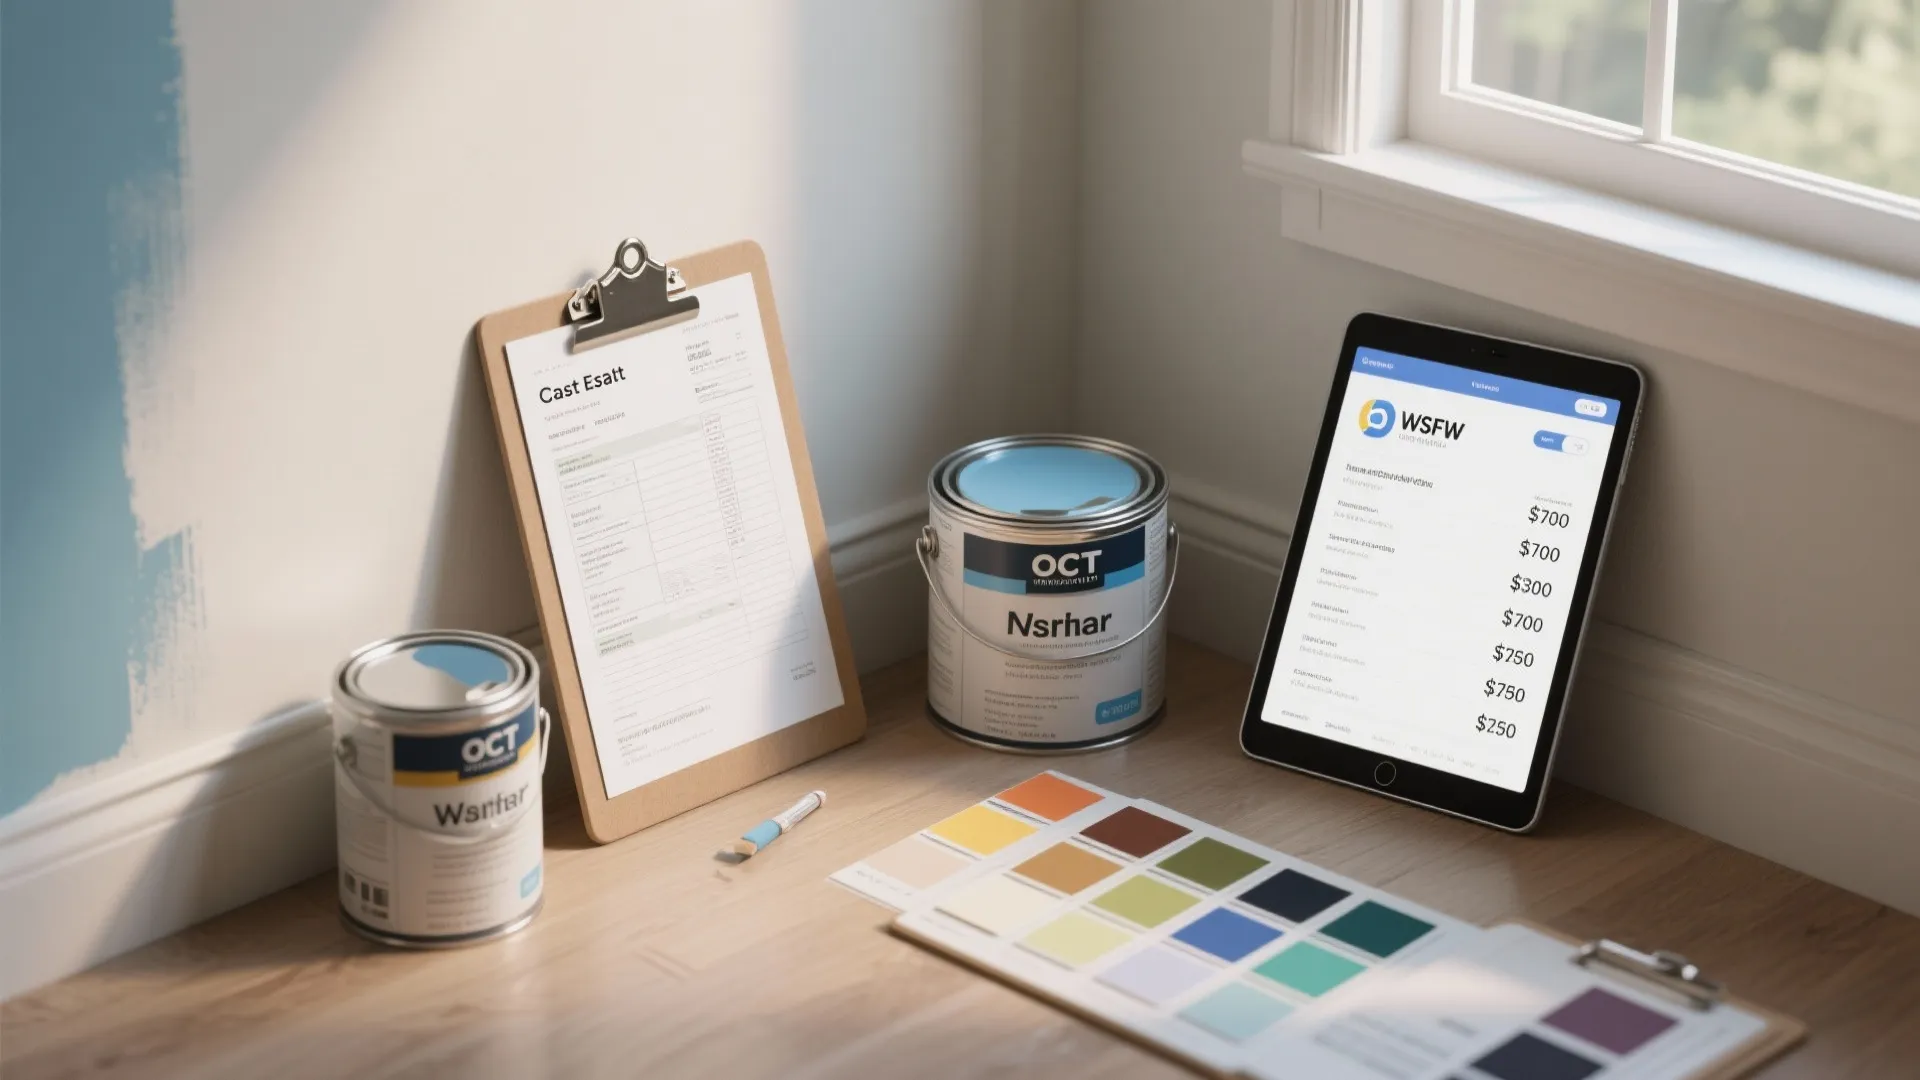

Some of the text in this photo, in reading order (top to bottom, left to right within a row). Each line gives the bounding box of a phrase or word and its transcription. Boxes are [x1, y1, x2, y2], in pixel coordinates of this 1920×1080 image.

[539, 379, 580, 404] Cast
[1401, 410, 1466, 441] WSFW
[1528, 504, 1570, 529] $700
[1031, 549, 1103, 577] OCT
[1518, 538, 1561, 563] $700
[1509, 573, 1553, 598] $300
[1501, 607, 1544, 633] $700
[1492, 642, 1535, 668] $750
[1483, 677, 1526, 703] $750
[1475, 713, 1517, 739] $250
[462, 724, 519, 763] OCT
